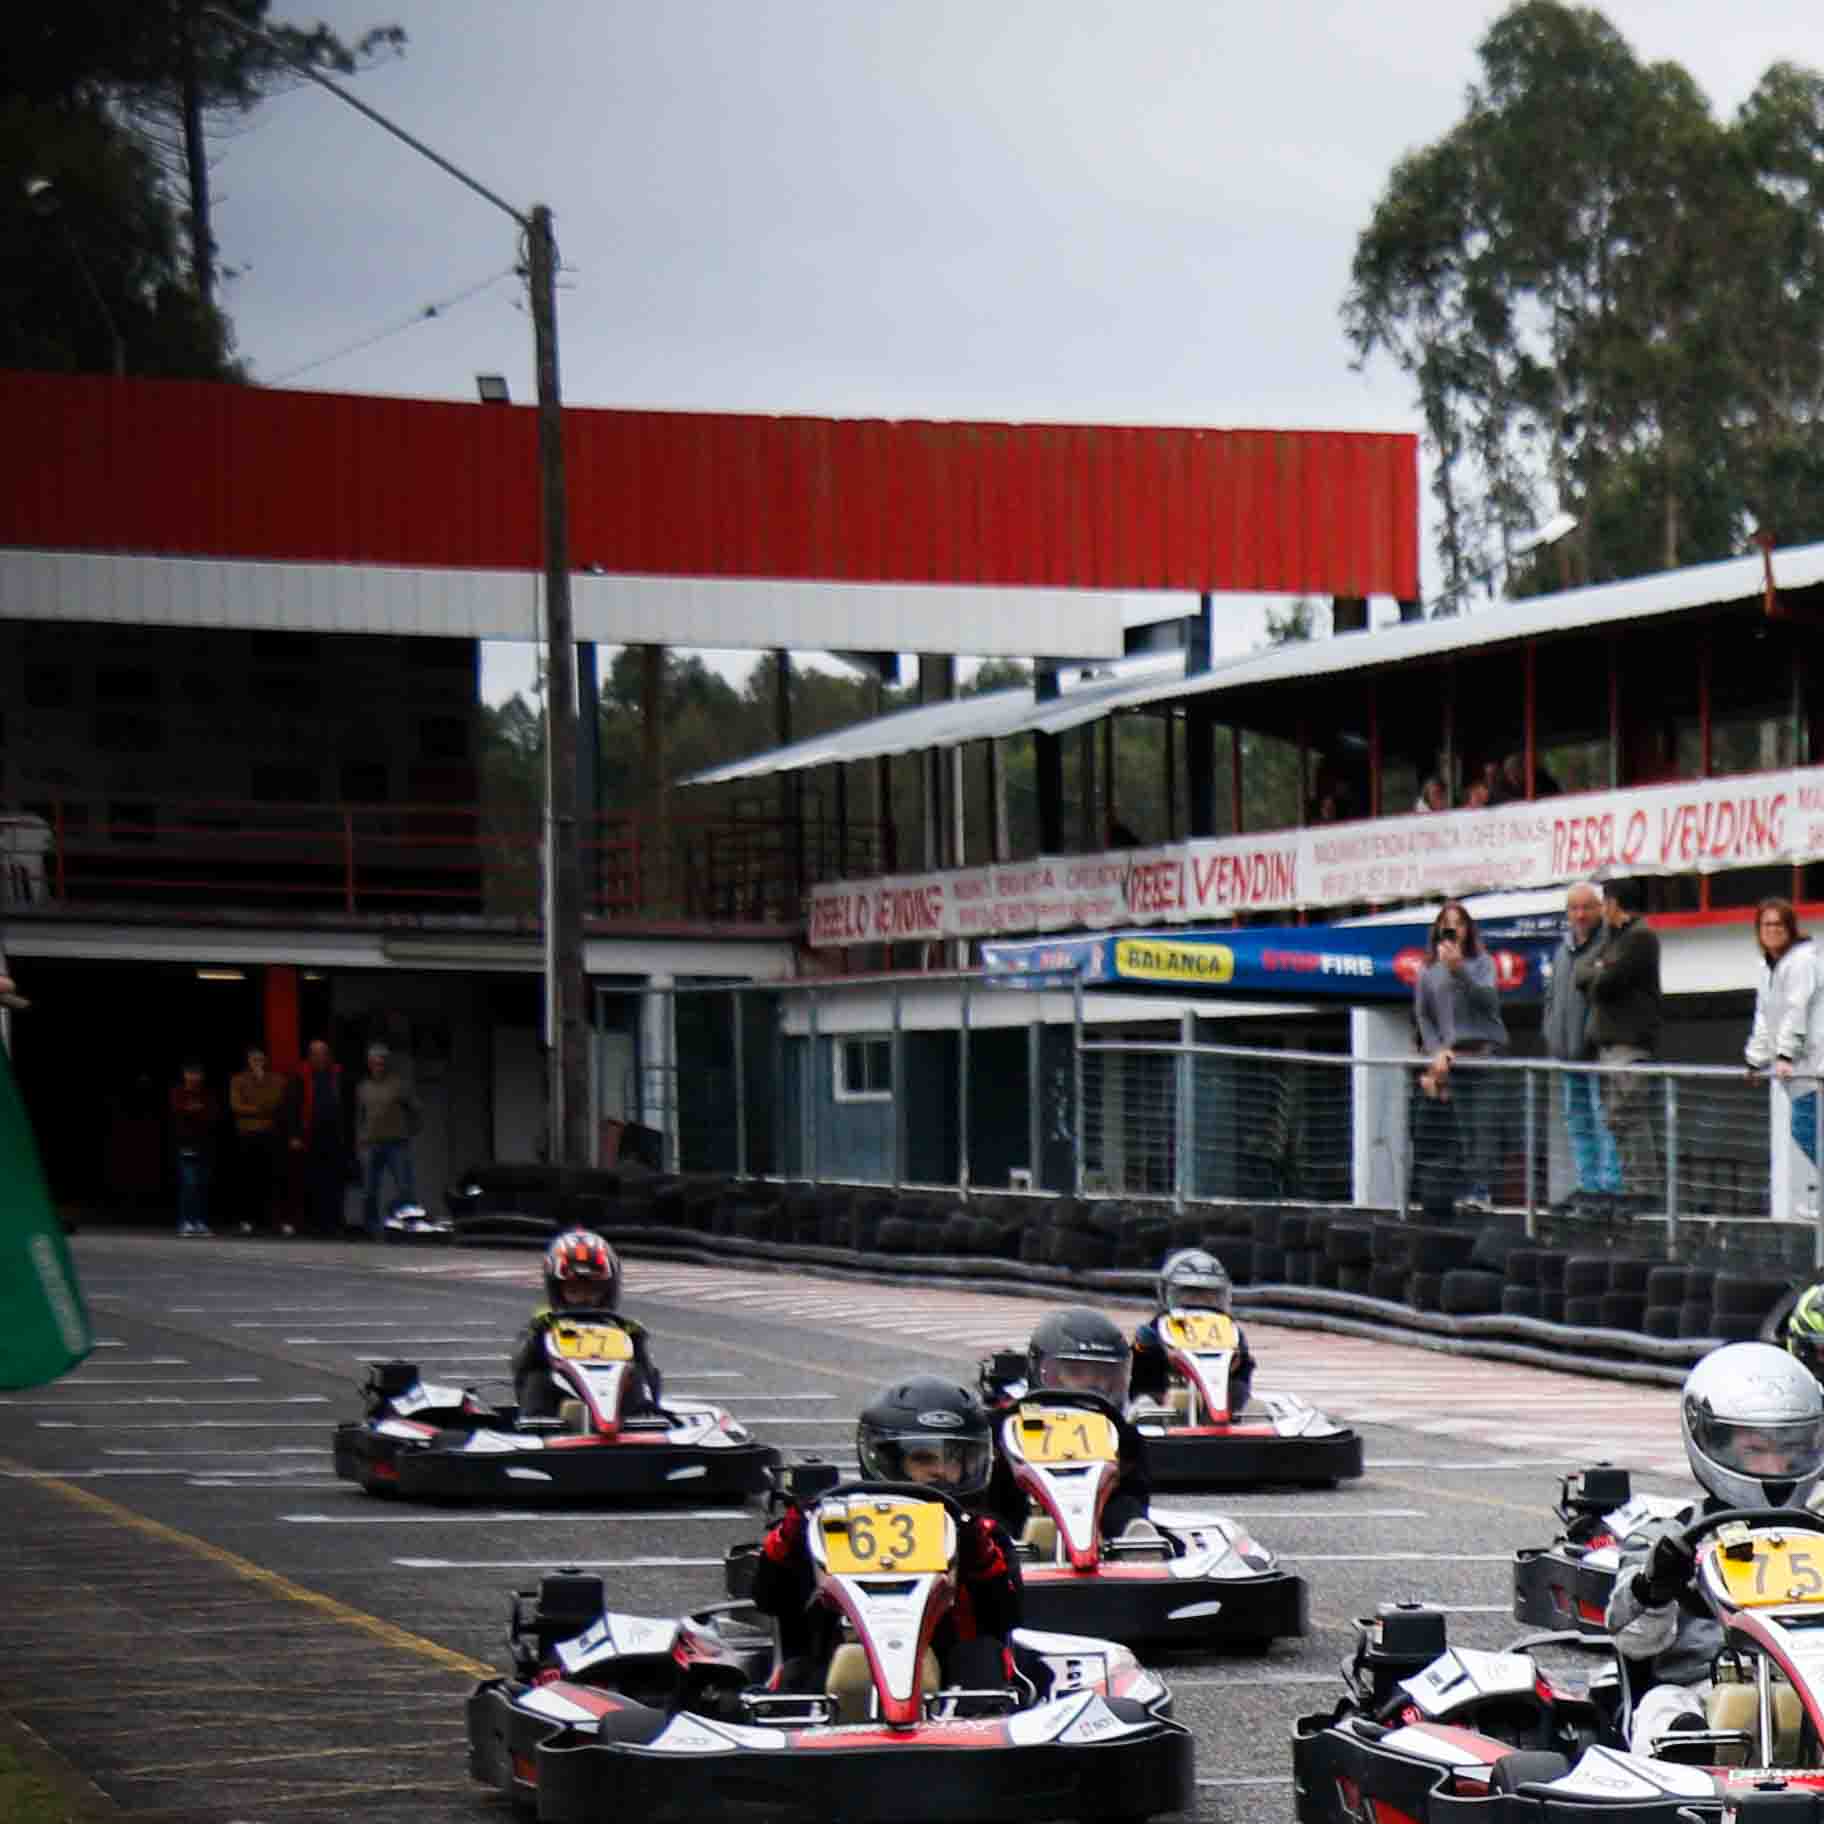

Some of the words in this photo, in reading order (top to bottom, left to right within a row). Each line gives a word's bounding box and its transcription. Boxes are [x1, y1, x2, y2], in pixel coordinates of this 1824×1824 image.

[1660, 793, 1788, 864] VENDING
[849, 1513, 915, 1561] 63
[1751, 1552, 1824, 1595] 75
